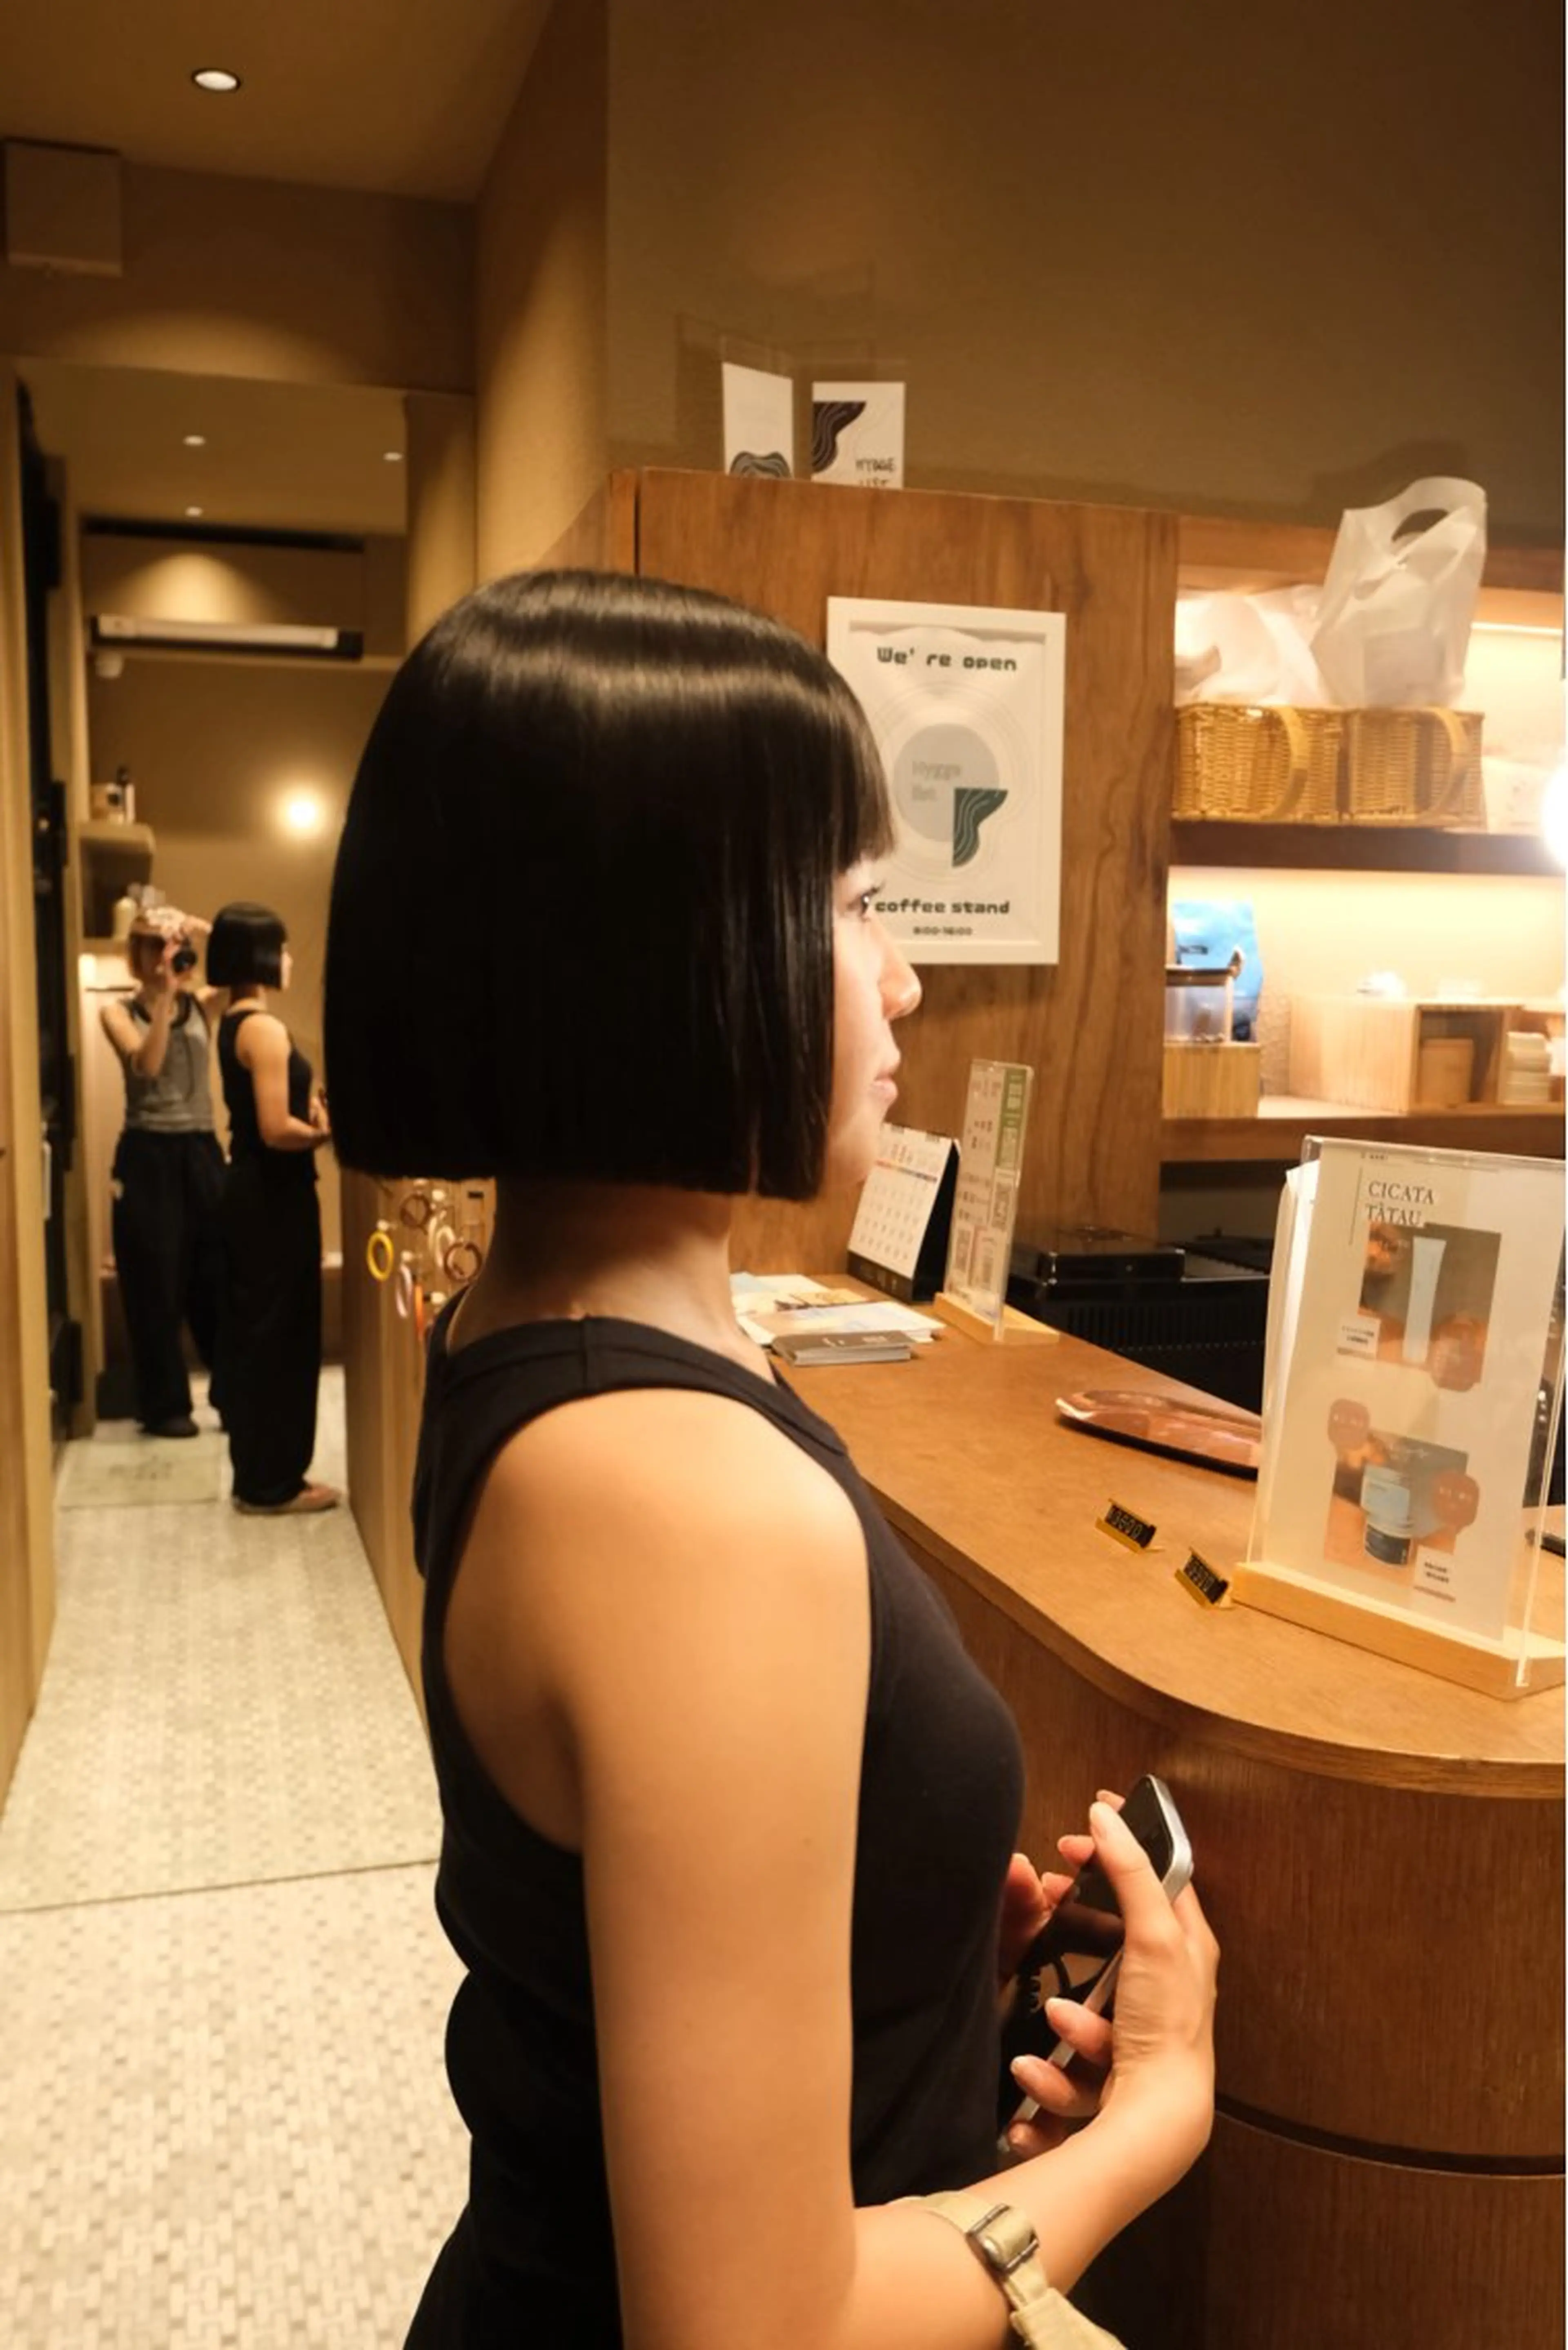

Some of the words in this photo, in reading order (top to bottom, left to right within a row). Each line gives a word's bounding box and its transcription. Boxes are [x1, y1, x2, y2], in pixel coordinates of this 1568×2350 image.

[962, 656, 1017, 671] open
[875, 898, 947, 913] coffee
[951, 900, 1010, 914] stand
[1368, 1180, 1434, 1205] CICATA
